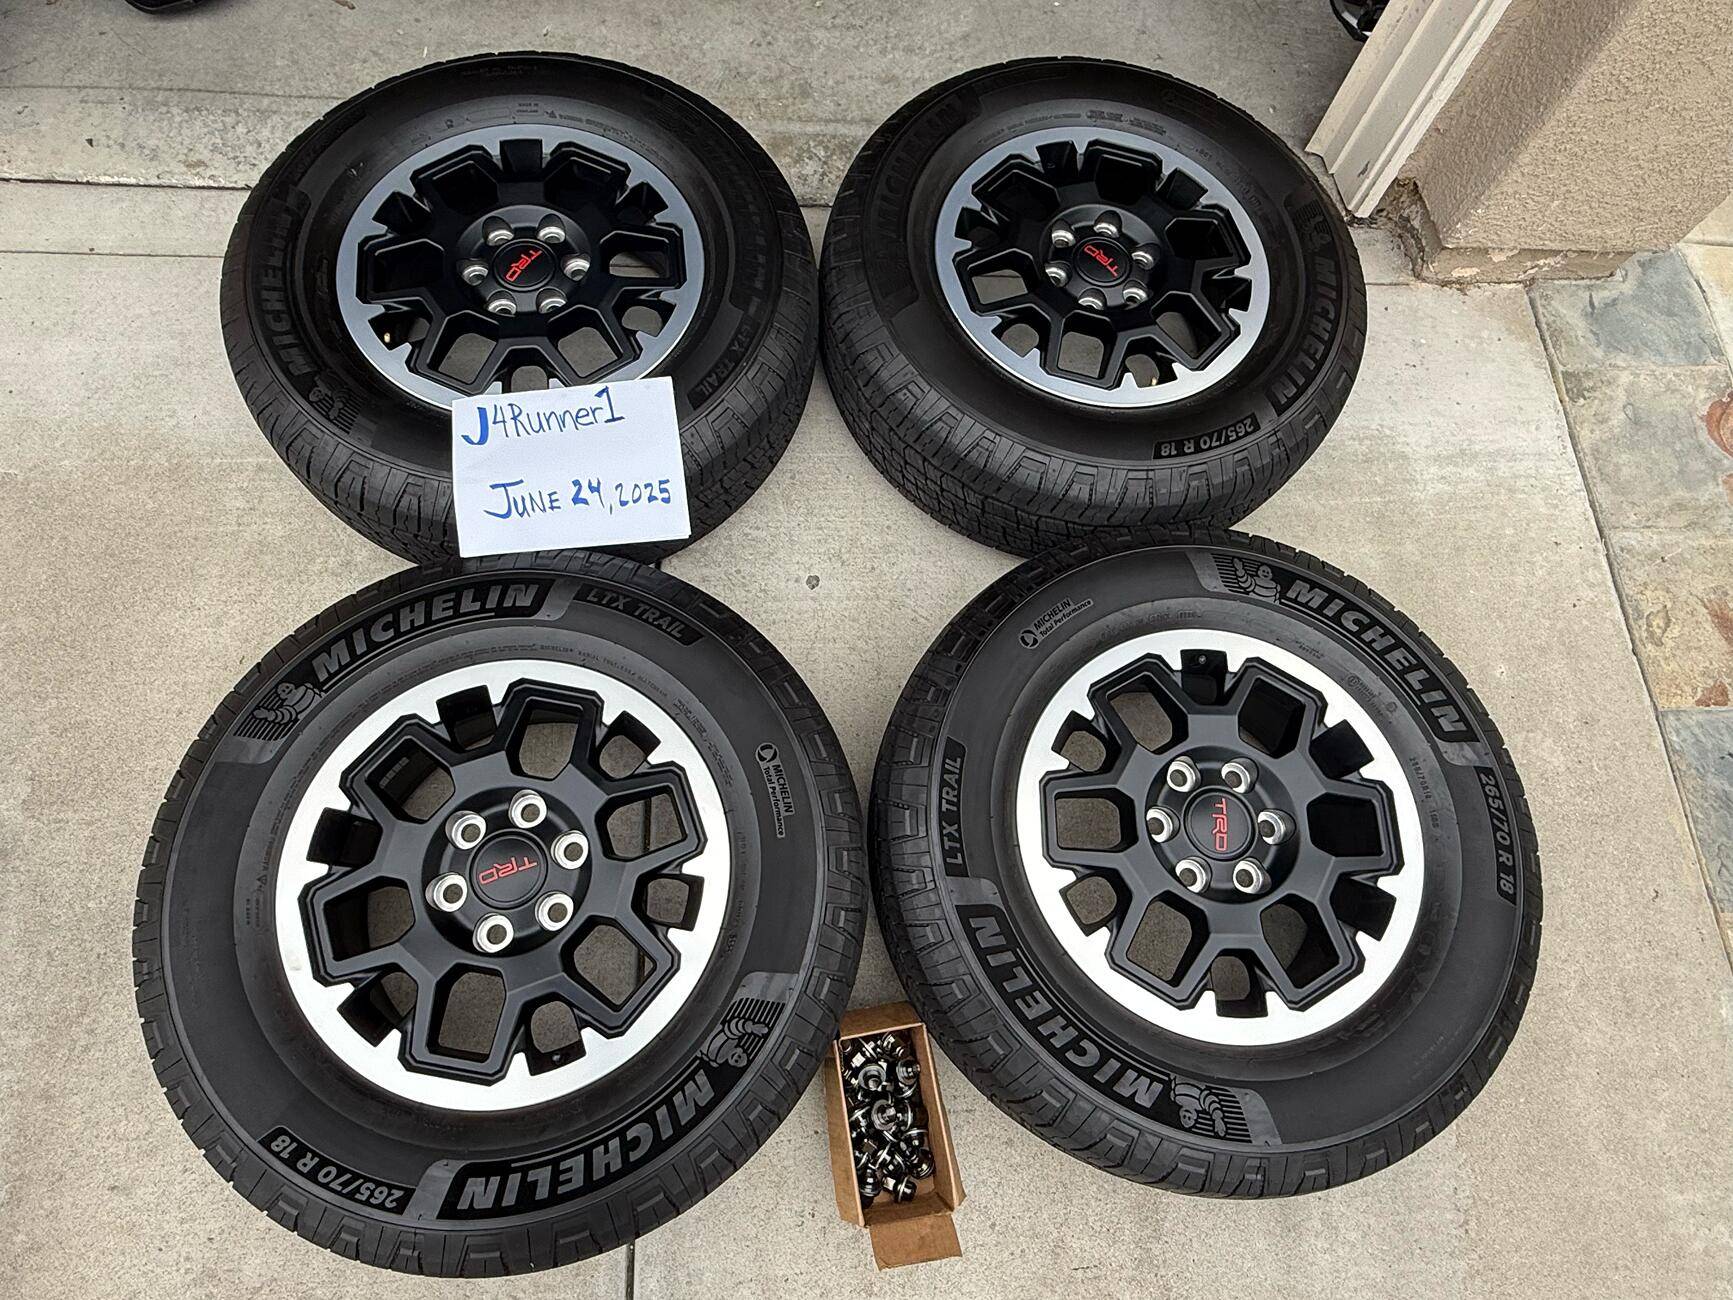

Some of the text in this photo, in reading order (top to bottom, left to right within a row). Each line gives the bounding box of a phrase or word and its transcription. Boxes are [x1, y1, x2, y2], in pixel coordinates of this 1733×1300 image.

[505, 249, 543, 282] TRD
[1083, 244, 1119, 277] TRD
[1270, 254, 1338, 406] MICHELIN
[461, 386, 625, 446] J4Runner1
[1160, 416, 1256, 457] 265/70 R 18
[483, 478, 562, 520] JUNE
[311, 583, 540, 683] MICHELIN
[586, 587, 686, 638] LTX TRAIL
[1033, 598, 1072, 631] MICHELIN
[1039, 622, 1055, 638] Total
[1053, 600, 1092, 626] Performance
[1286, 579, 1467, 732] MICHELIN
[763, 766, 785, 836] Total Performance
[771, 763, 795, 814] MICHELIN
[942, 757, 963, 865] LTX TRAIL
[1212, 797, 1228, 852] TRD
[1480, 772, 1515, 896] 265/70 R 18
[478, 856, 538, 885] TRD
[968, 916, 1164, 1109] MICHELIN
[456, 1068, 716, 1211] MICHELIN
[270, 1135, 406, 1209] 265/70 R 18
